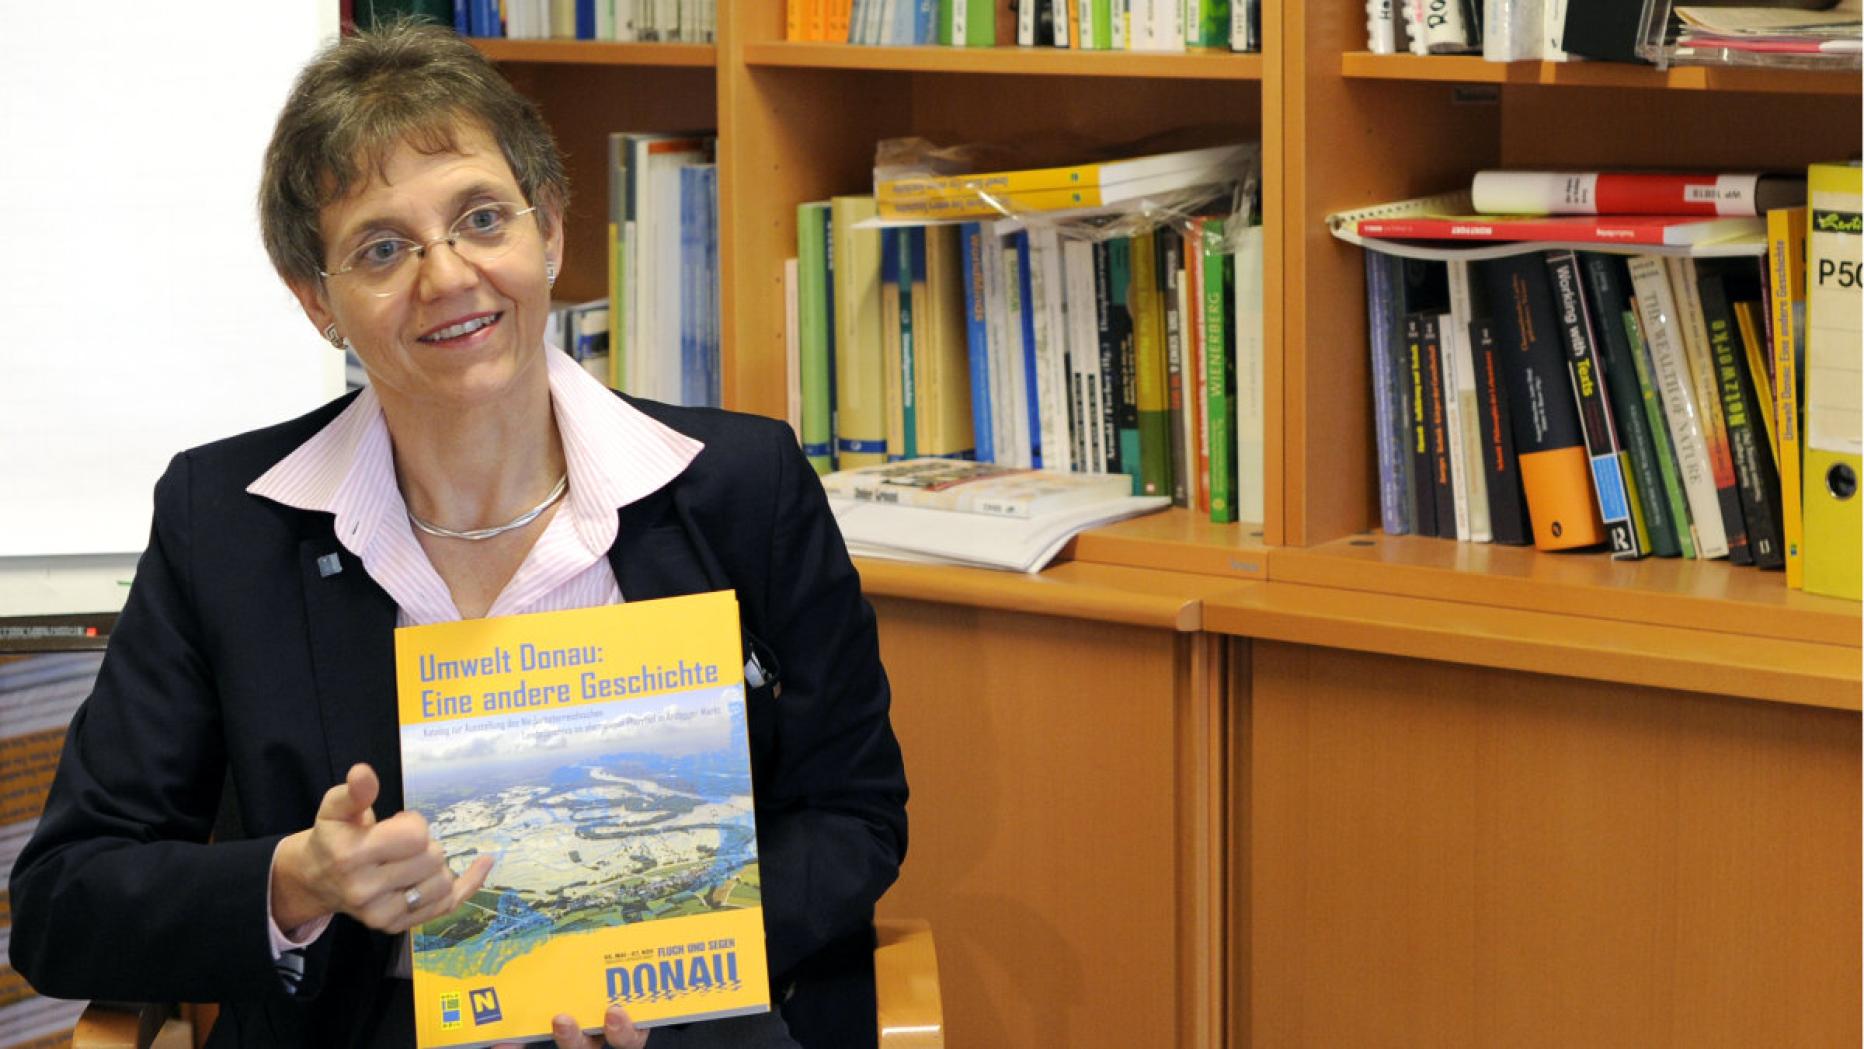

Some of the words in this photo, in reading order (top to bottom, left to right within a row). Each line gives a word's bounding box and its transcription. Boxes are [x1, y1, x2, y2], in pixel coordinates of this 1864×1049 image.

[1773, 240, 1787, 297] Geschichte
[1554, 265, 1580, 324] Working
[1642, 292, 1663, 325] THE
[1209, 292, 1221, 397] WIENERBERG
[1569, 324, 1588, 357] with
[1652, 328, 1682, 394] WEALTH
[1576, 357, 1595, 397] Texts
[1668, 394, 1685, 416] OF
[1673, 420, 1703, 485] NATURE
[419, 647, 511, 682] Umwelt
[519, 643, 604, 672] Donau:
[421, 688, 473, 719] Eine
[483, 680, 570, 711] andere
[581, 660, 719, 701] Geschichte
[474, 991, 495, 1012] N
[605, 952, 741, 1002] DONAU
